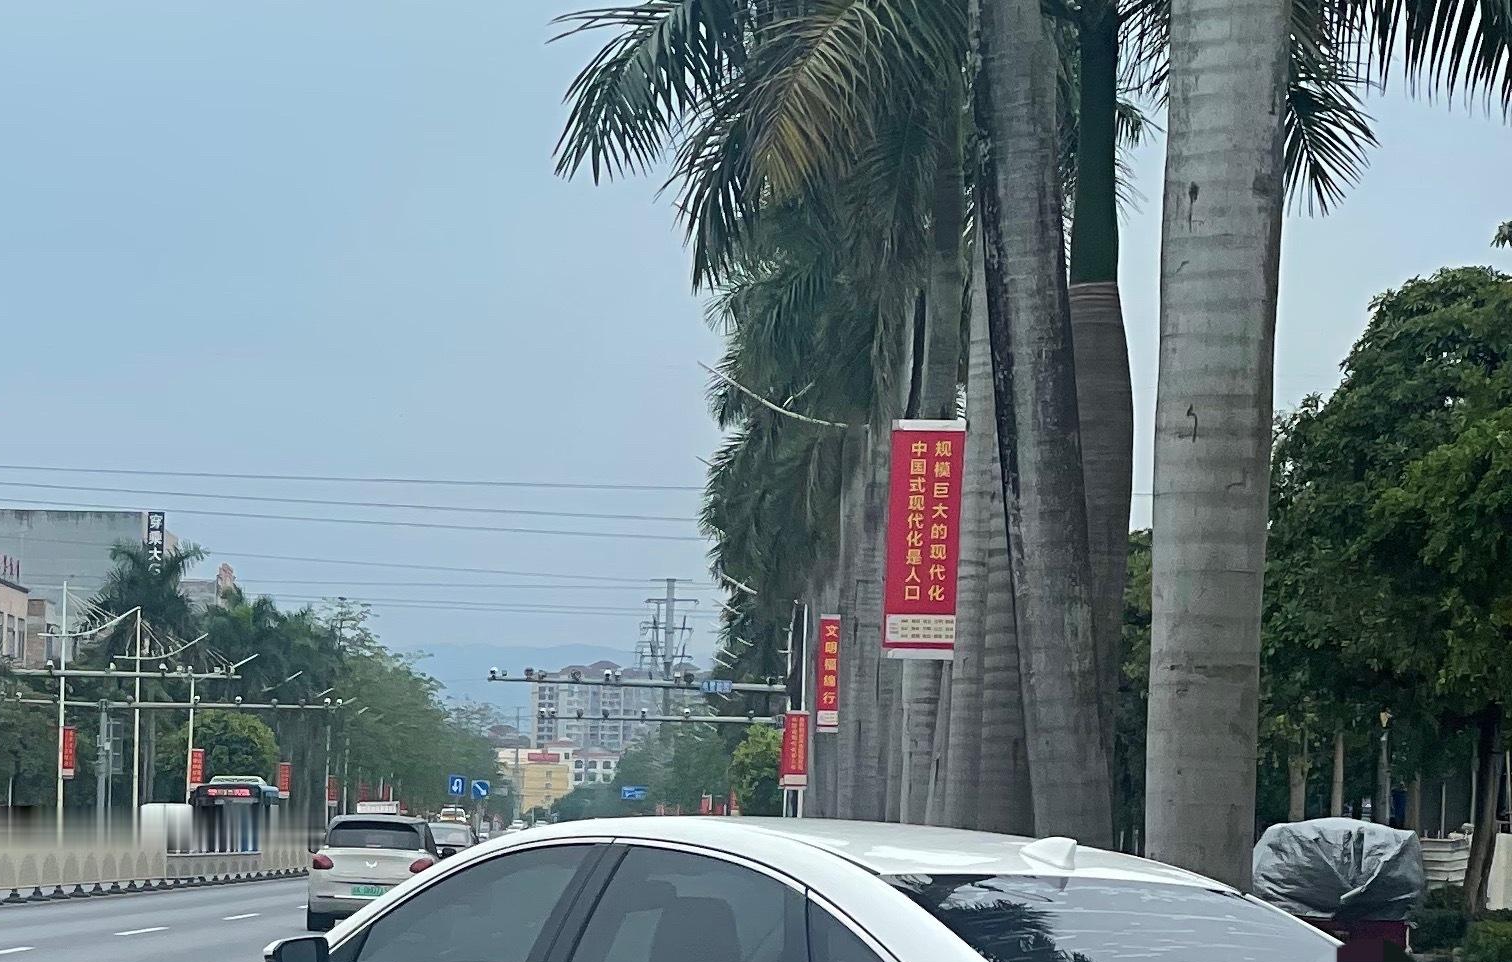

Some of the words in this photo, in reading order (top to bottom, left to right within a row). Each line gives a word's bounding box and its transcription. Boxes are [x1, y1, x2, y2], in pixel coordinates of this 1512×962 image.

[904, 440, 928, 601] 中国式现代化是人口
[927, 440, 952, 602] 规模巨大的现代化
